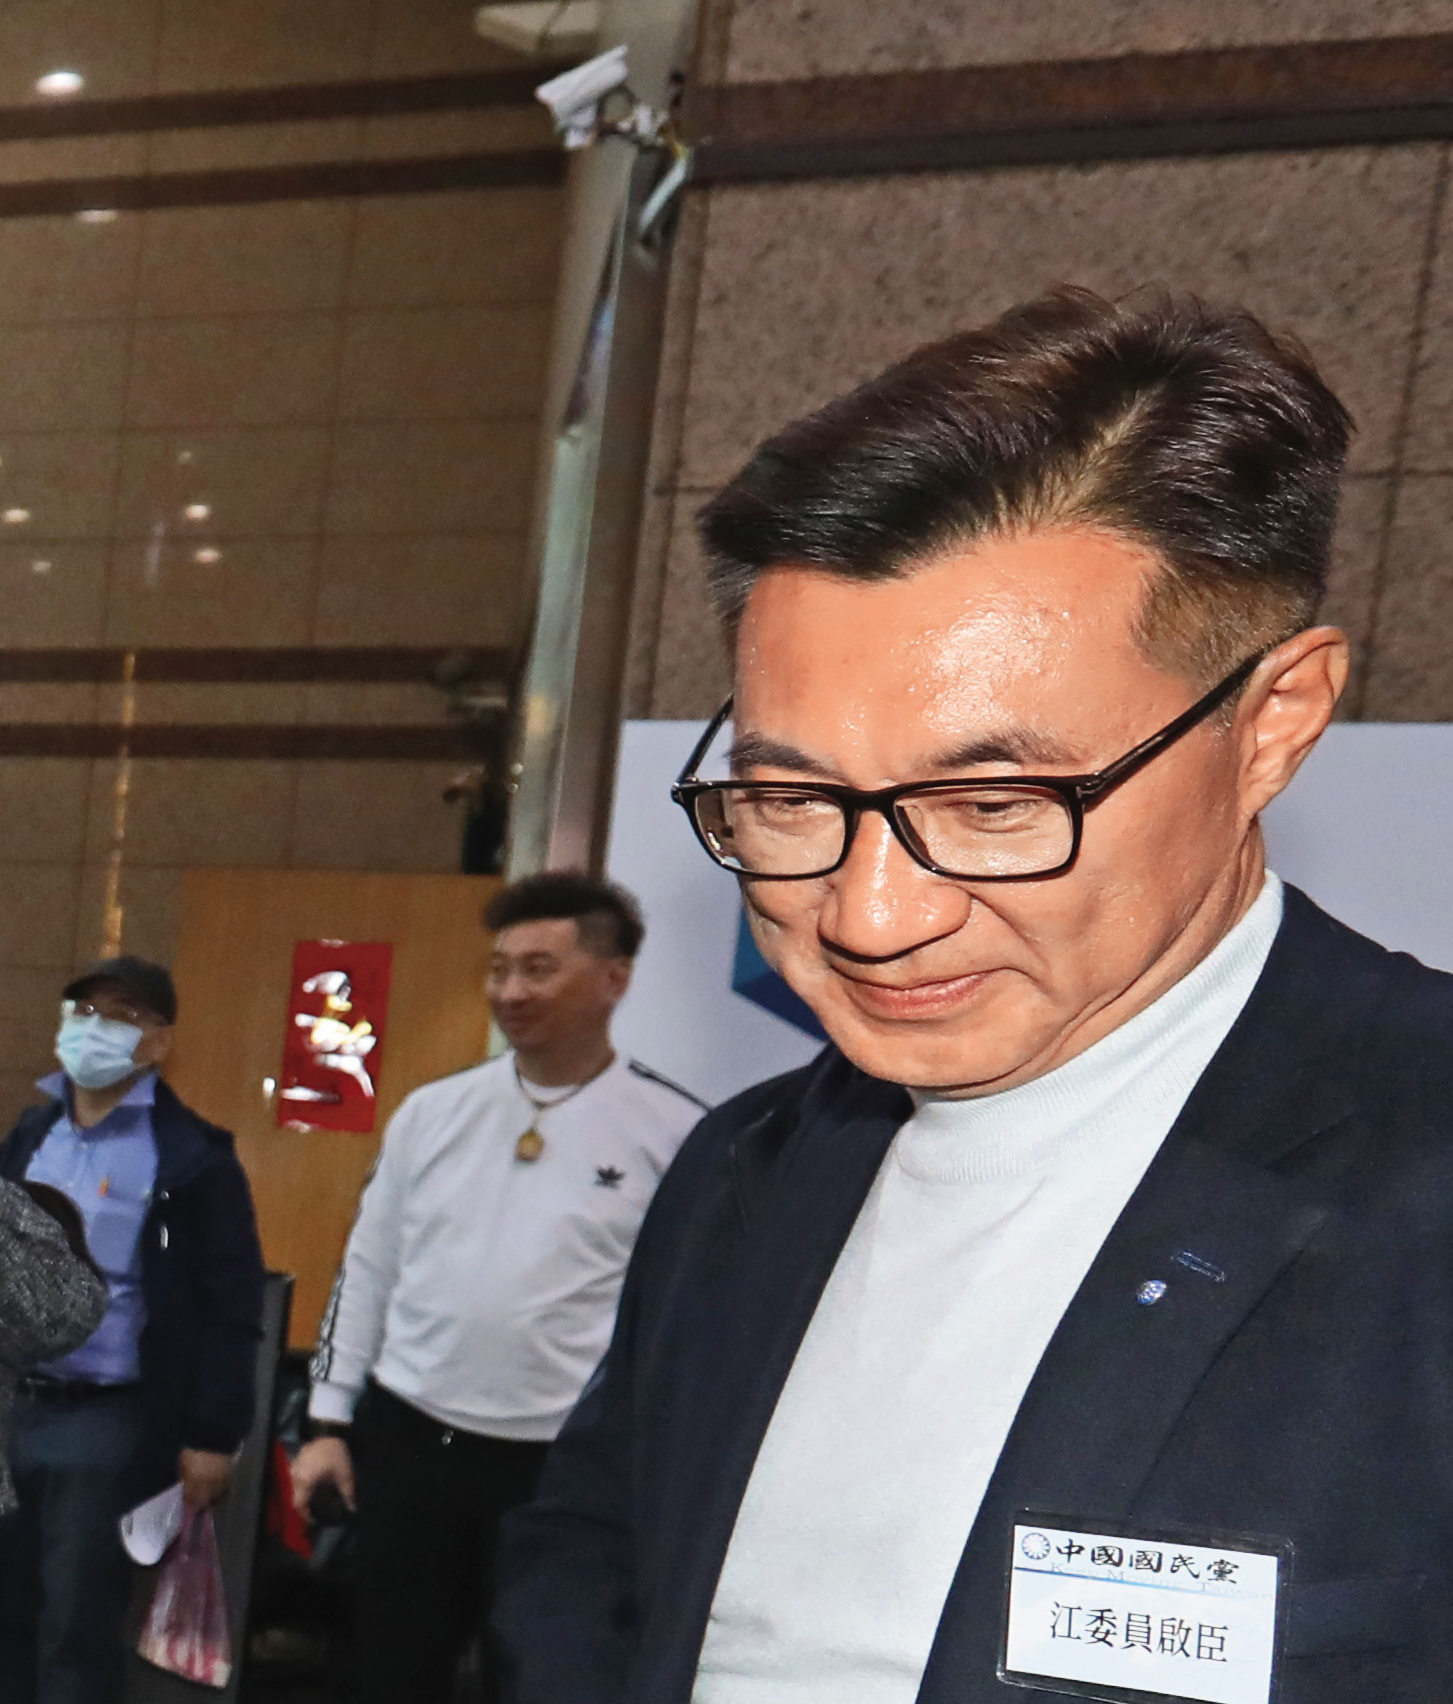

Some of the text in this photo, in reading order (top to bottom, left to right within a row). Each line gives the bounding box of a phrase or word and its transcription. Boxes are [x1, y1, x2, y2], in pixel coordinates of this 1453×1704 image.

[1056, 1538, 1240, 1585] 中國國民黨
[1050, 1601, 1230, 1663] 江委員啟臣
